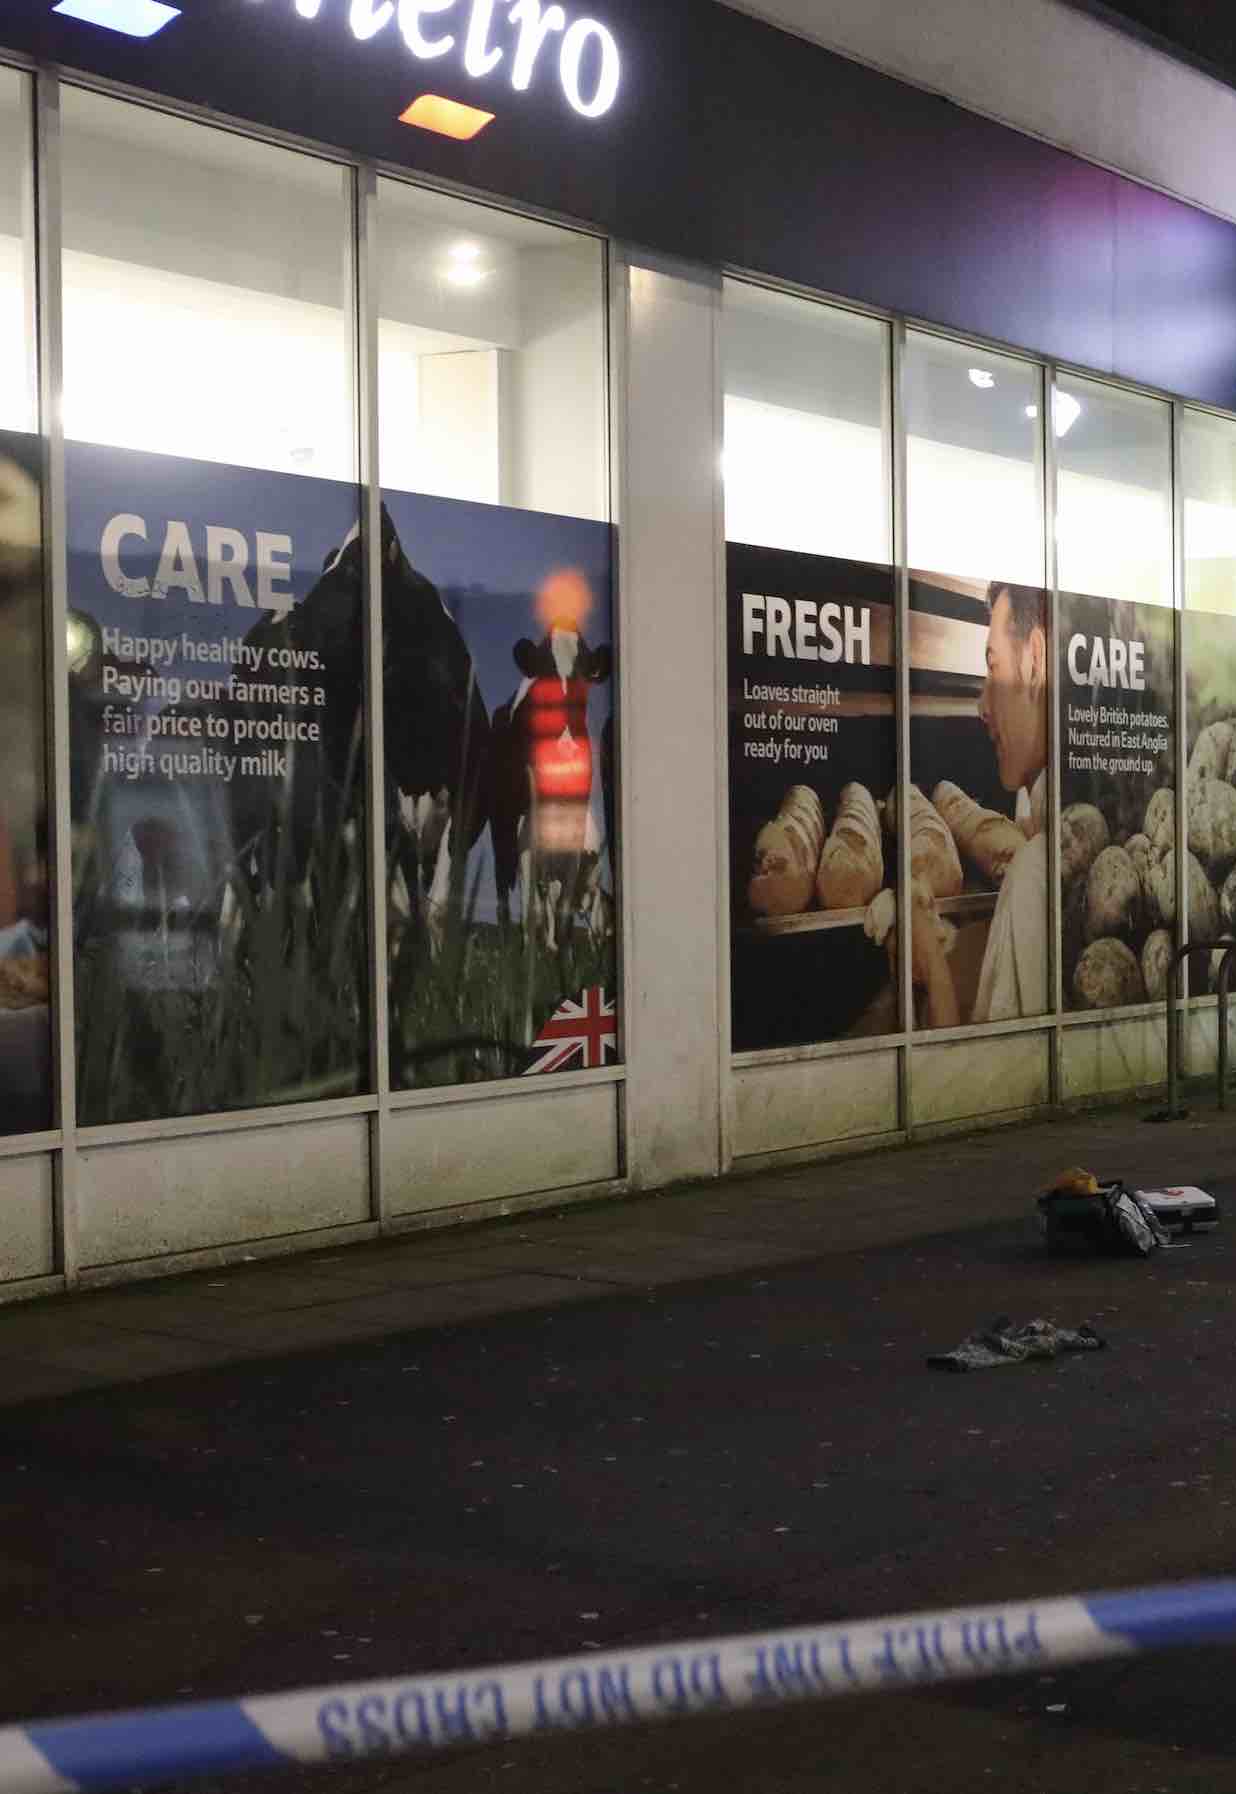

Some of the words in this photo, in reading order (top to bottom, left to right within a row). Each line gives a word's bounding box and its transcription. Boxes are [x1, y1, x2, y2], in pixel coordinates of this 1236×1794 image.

[100, 513, 296, 612] CARE
[741, 593, 871, 666] FRESH
[102, 627, 178, 665] Happy
[181, 633, 264, 672] healthy
[267, 648, 327, 671] cows.
[1067, 633, 1145, 690] CARE
[102, 665, 181, 704] Paying
[185, 678, 226, 700] our
[228, 675, 310, 704] farmers
[313, 690, 326, 706] a
[743, 677, 790, 702] Loaves
[791, 683, 841, 709] straight
[102, 704, 144, 735] fair
[146, 708, 202, 742] price
[206, 713, 229, 738] to
[233, 713, 321, 745] produce
[743, 710, 768, 730] out
[769, 709, 785, 731] of
[785, 717, 807, 732] our
[807, 717, 839, 733] oven
[1068, 703, 1100, 727] Lovely
[1100, 705, 1129, 726] British
[1130, 711, 1169, 728] potatoes.
[743, 737, 783, 764] ready
[783, 738, 803, 760] for
[803, 743, 829, 764] you
[1068, 727, 1111, 747] Nurtured
[1111, 729, 1121, 748] in
[1121, 731, 1142, 749] East
[1142, 733, 1169, 754] Anglia
[102, 743, 155, 780] high
[159, 747, 237, 782] quality
[240, 748, 289, 777] milk
[1068, 752, 1092, 770] from
[1092, 752, 1108, 770] the
[1108, 755, 1142, 775] ground
